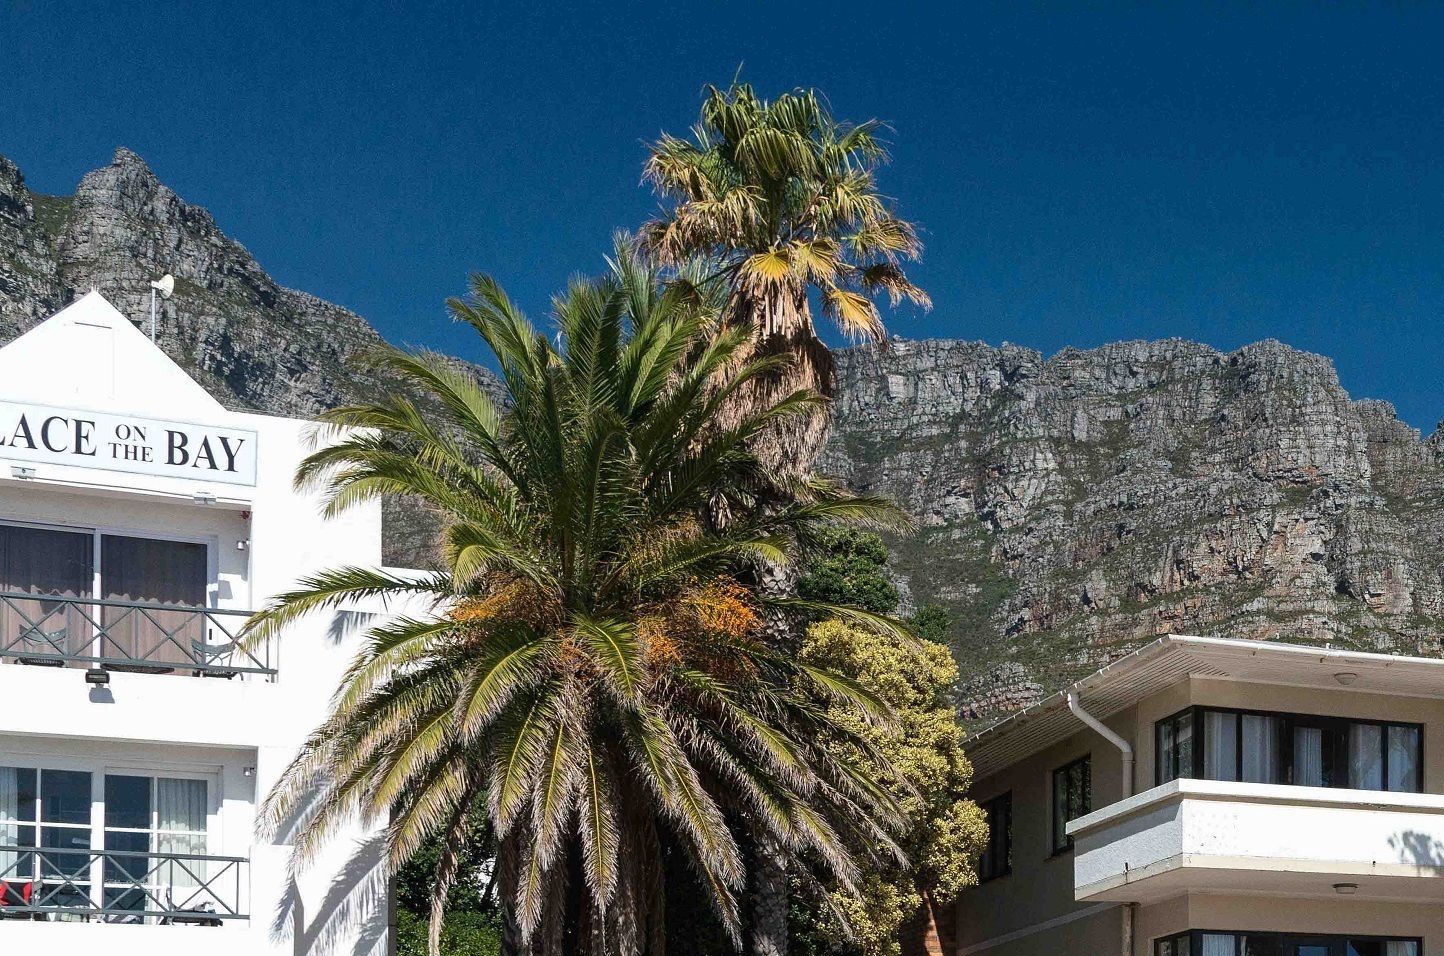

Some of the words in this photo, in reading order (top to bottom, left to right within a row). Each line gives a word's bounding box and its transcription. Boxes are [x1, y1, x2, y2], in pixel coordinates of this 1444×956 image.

[0, 412, 97, 457] ACE
[115, 423, 147, 443] ON
[108, 442, 154, 463] THE
[164, 429, 246, 473] BAY
